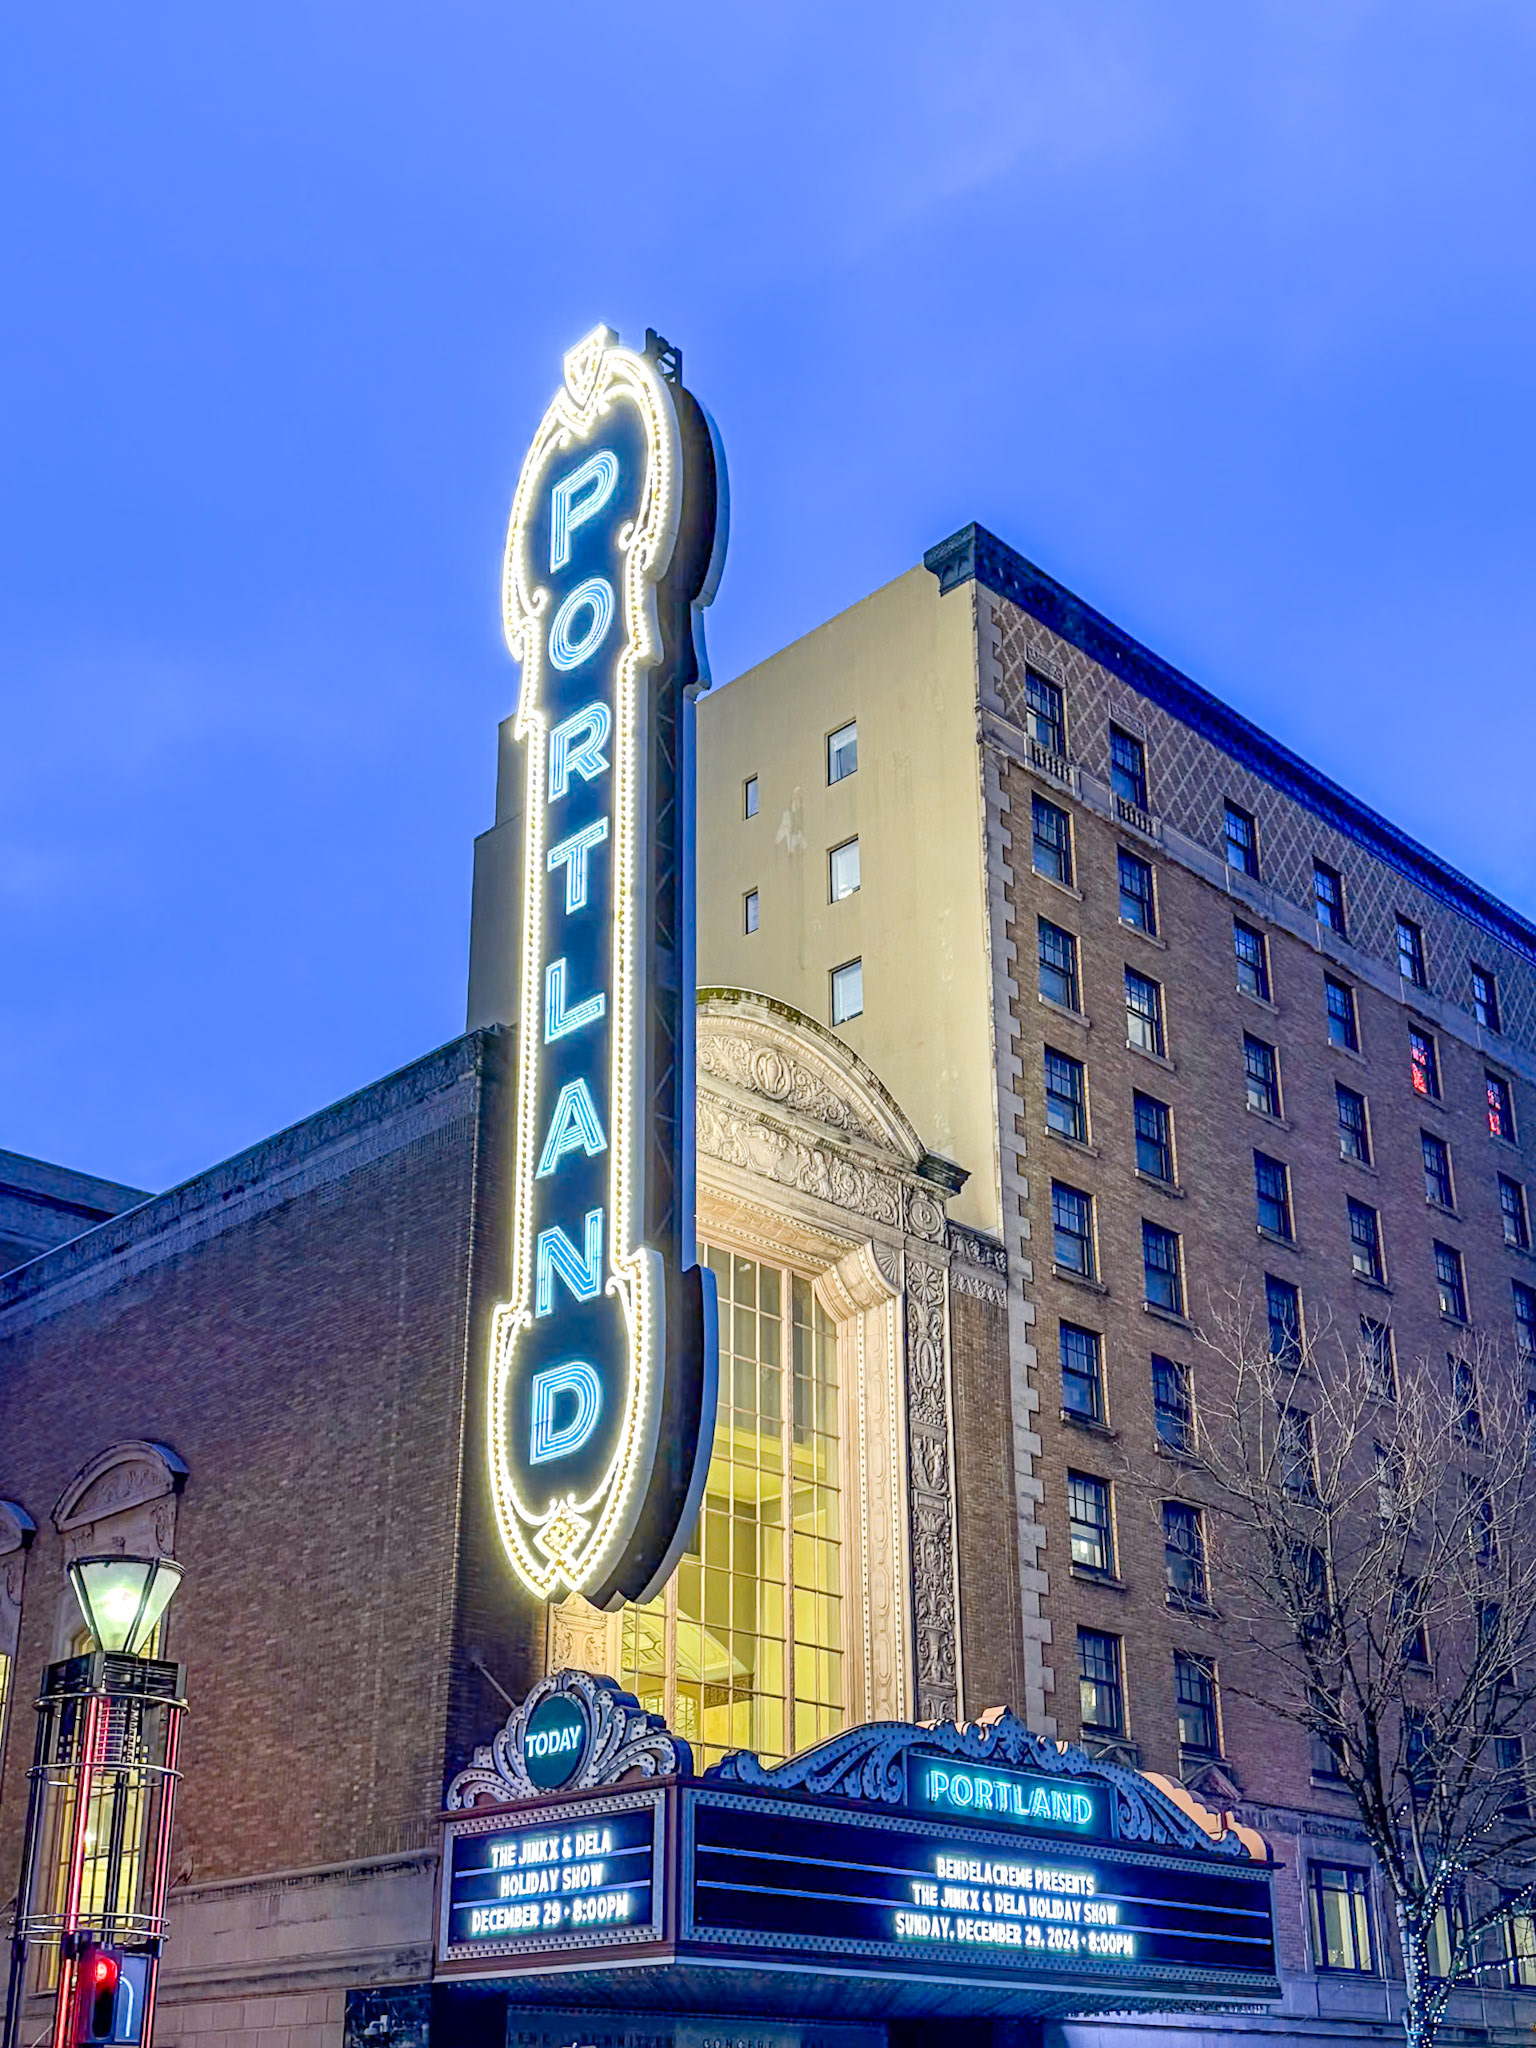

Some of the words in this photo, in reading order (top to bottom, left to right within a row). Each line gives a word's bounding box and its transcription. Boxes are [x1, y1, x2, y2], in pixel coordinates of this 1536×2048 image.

[528, 450, 619, 1466] PORTLAND
[525, 1726, 582, 1757] TODAY
[925, 1770, 1093, 1825] PORTLAND
[491, 1845, 517, 1868] THE
[518, 1837, 560, 1864] JINKX
[562, 1835, 573, 1859] &
[575, 1829, 612, 1856] DELA
[500, 1869, 560, 1898] HOLIDAY
[562, 1864, 603, 1889] SHOW
[936, 1856, 1033, 1889] BENDELACREME
[1035, 1869, 1095, 1896] PRESENTS
[471, 1904, 540, 1933] DECEMBER
[543, 1902, 561, 1925] 29
[572, 1894, 629, 1921] 8:00PM
[912, 1883, 938, 1906] THE
[940, 1887, 980, 1911] JINKX
[982, 1892, 992, 1912] &
[994, 1892, 1026, 1916] DELA
[1028, 1896, 1081, 1922] HOLIDAY
[1083, 1903, 1118, 1925] SHOW
[956, 1919, 1022, 1945] DECEMBER
[1046, 1927, 1079, 1951] 2024
[1088, 1931, 1133, 1955] 8:00PM
